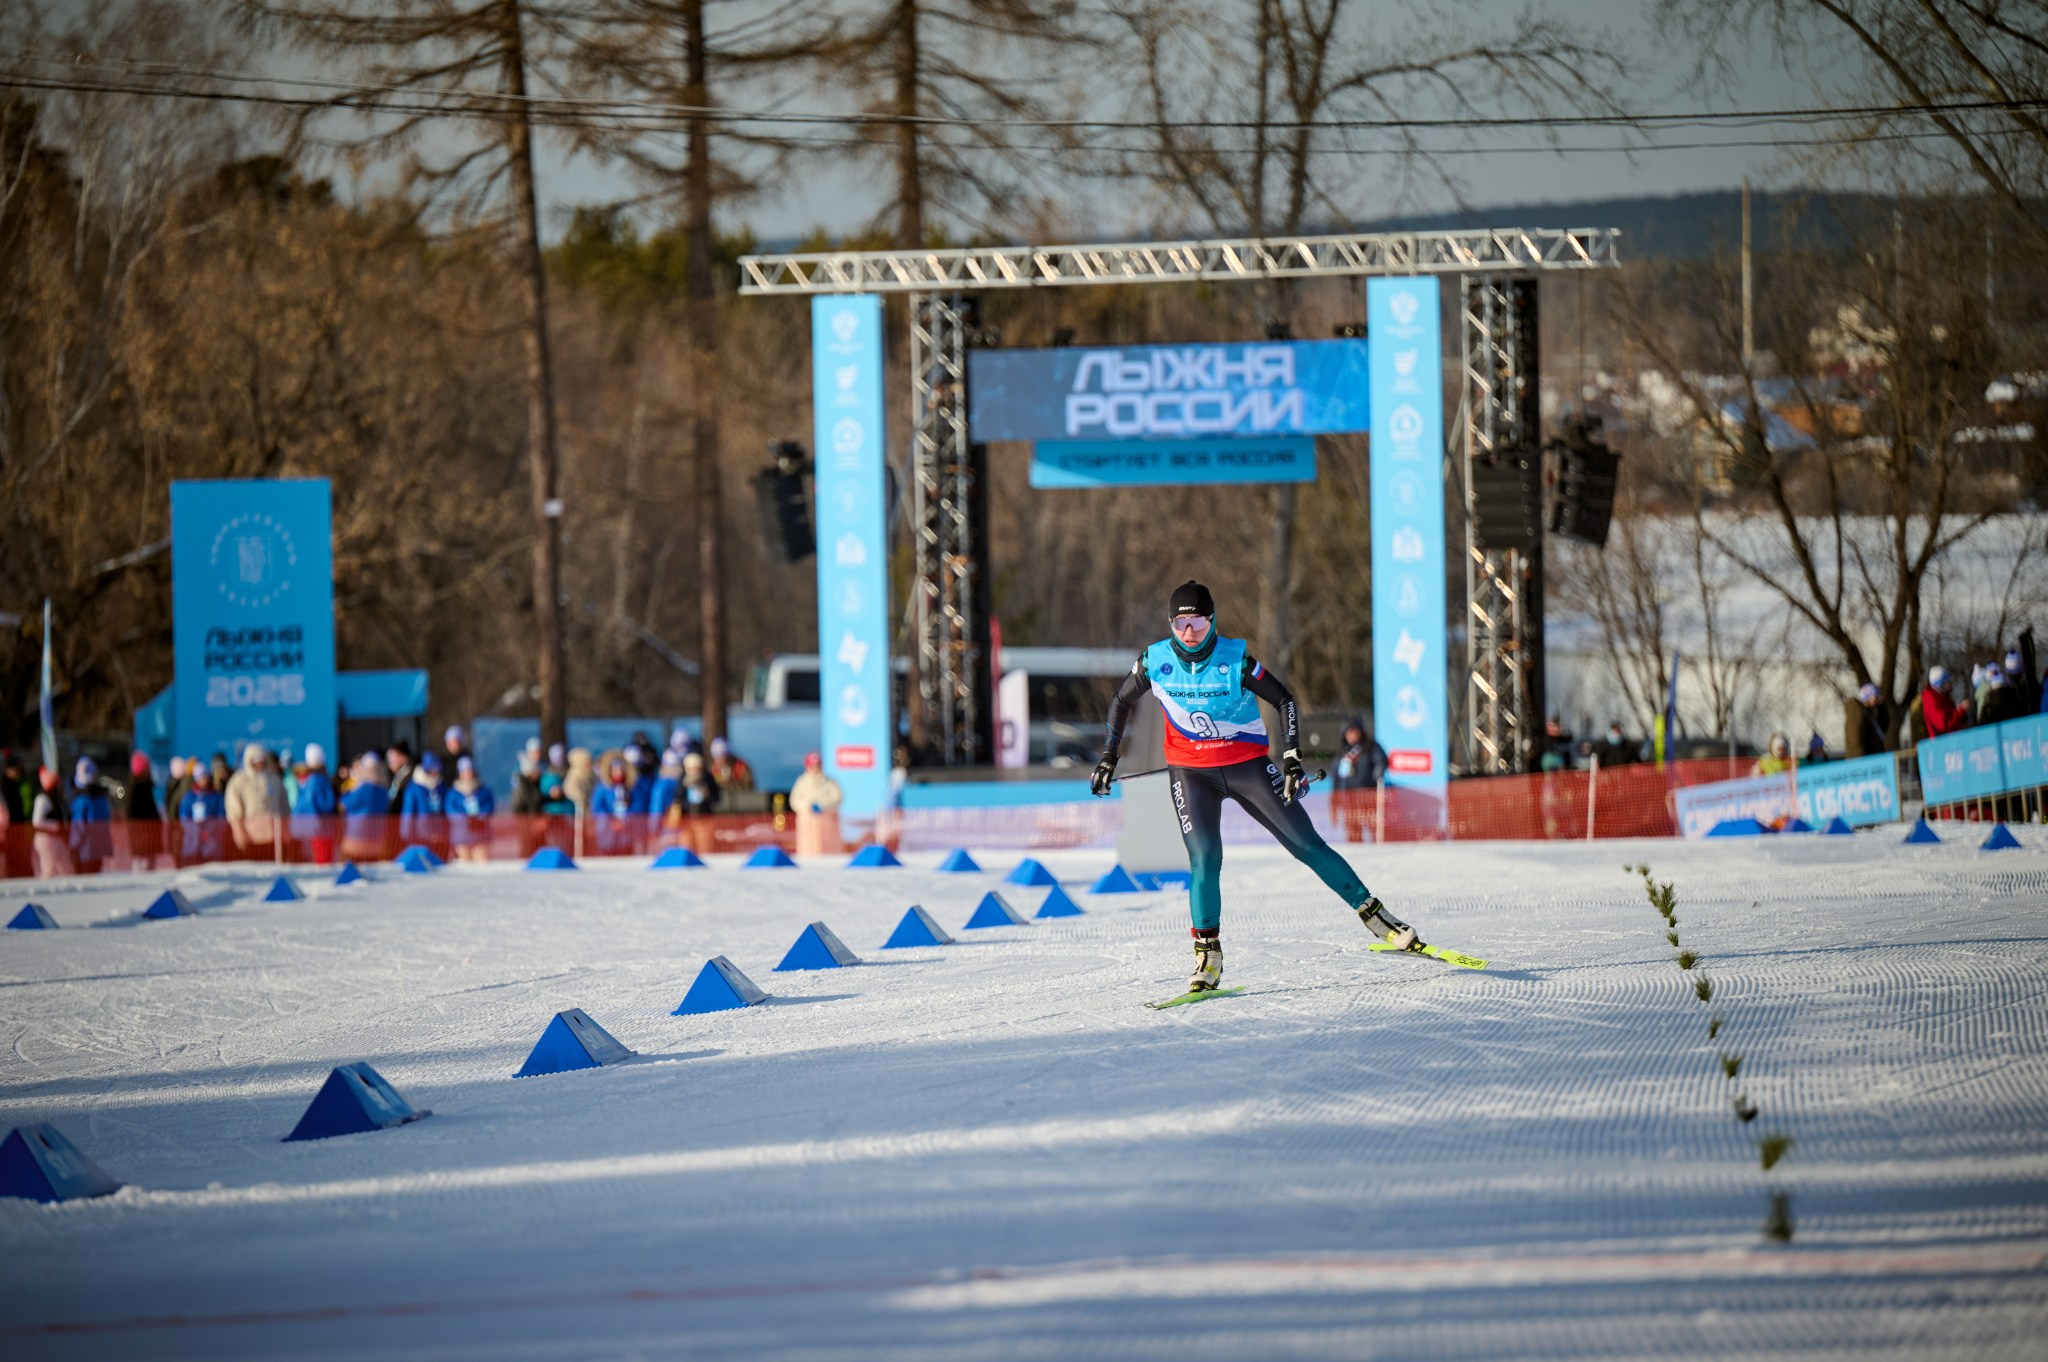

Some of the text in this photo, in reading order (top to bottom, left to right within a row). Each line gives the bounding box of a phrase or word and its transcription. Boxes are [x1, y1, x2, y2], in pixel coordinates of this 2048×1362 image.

[1073, 347, 1294, 392] ЛЫЖНЯ
[1066, 389, 1303, 435] РОССИИ
[205, 625, 303, 648] ЛЫЖНЯ
[204, 651, 303, 672] РОССИИ
[1198, 690, 1230, 698] РОССИИ
[1190, 711, 1219, 738] 9
[1288, 701, 1296, 736] PROLAB
[1172, 780, 1193, 834] PROLAB
[1815, 779, 1892, 819] ОБЛАСТЬ
